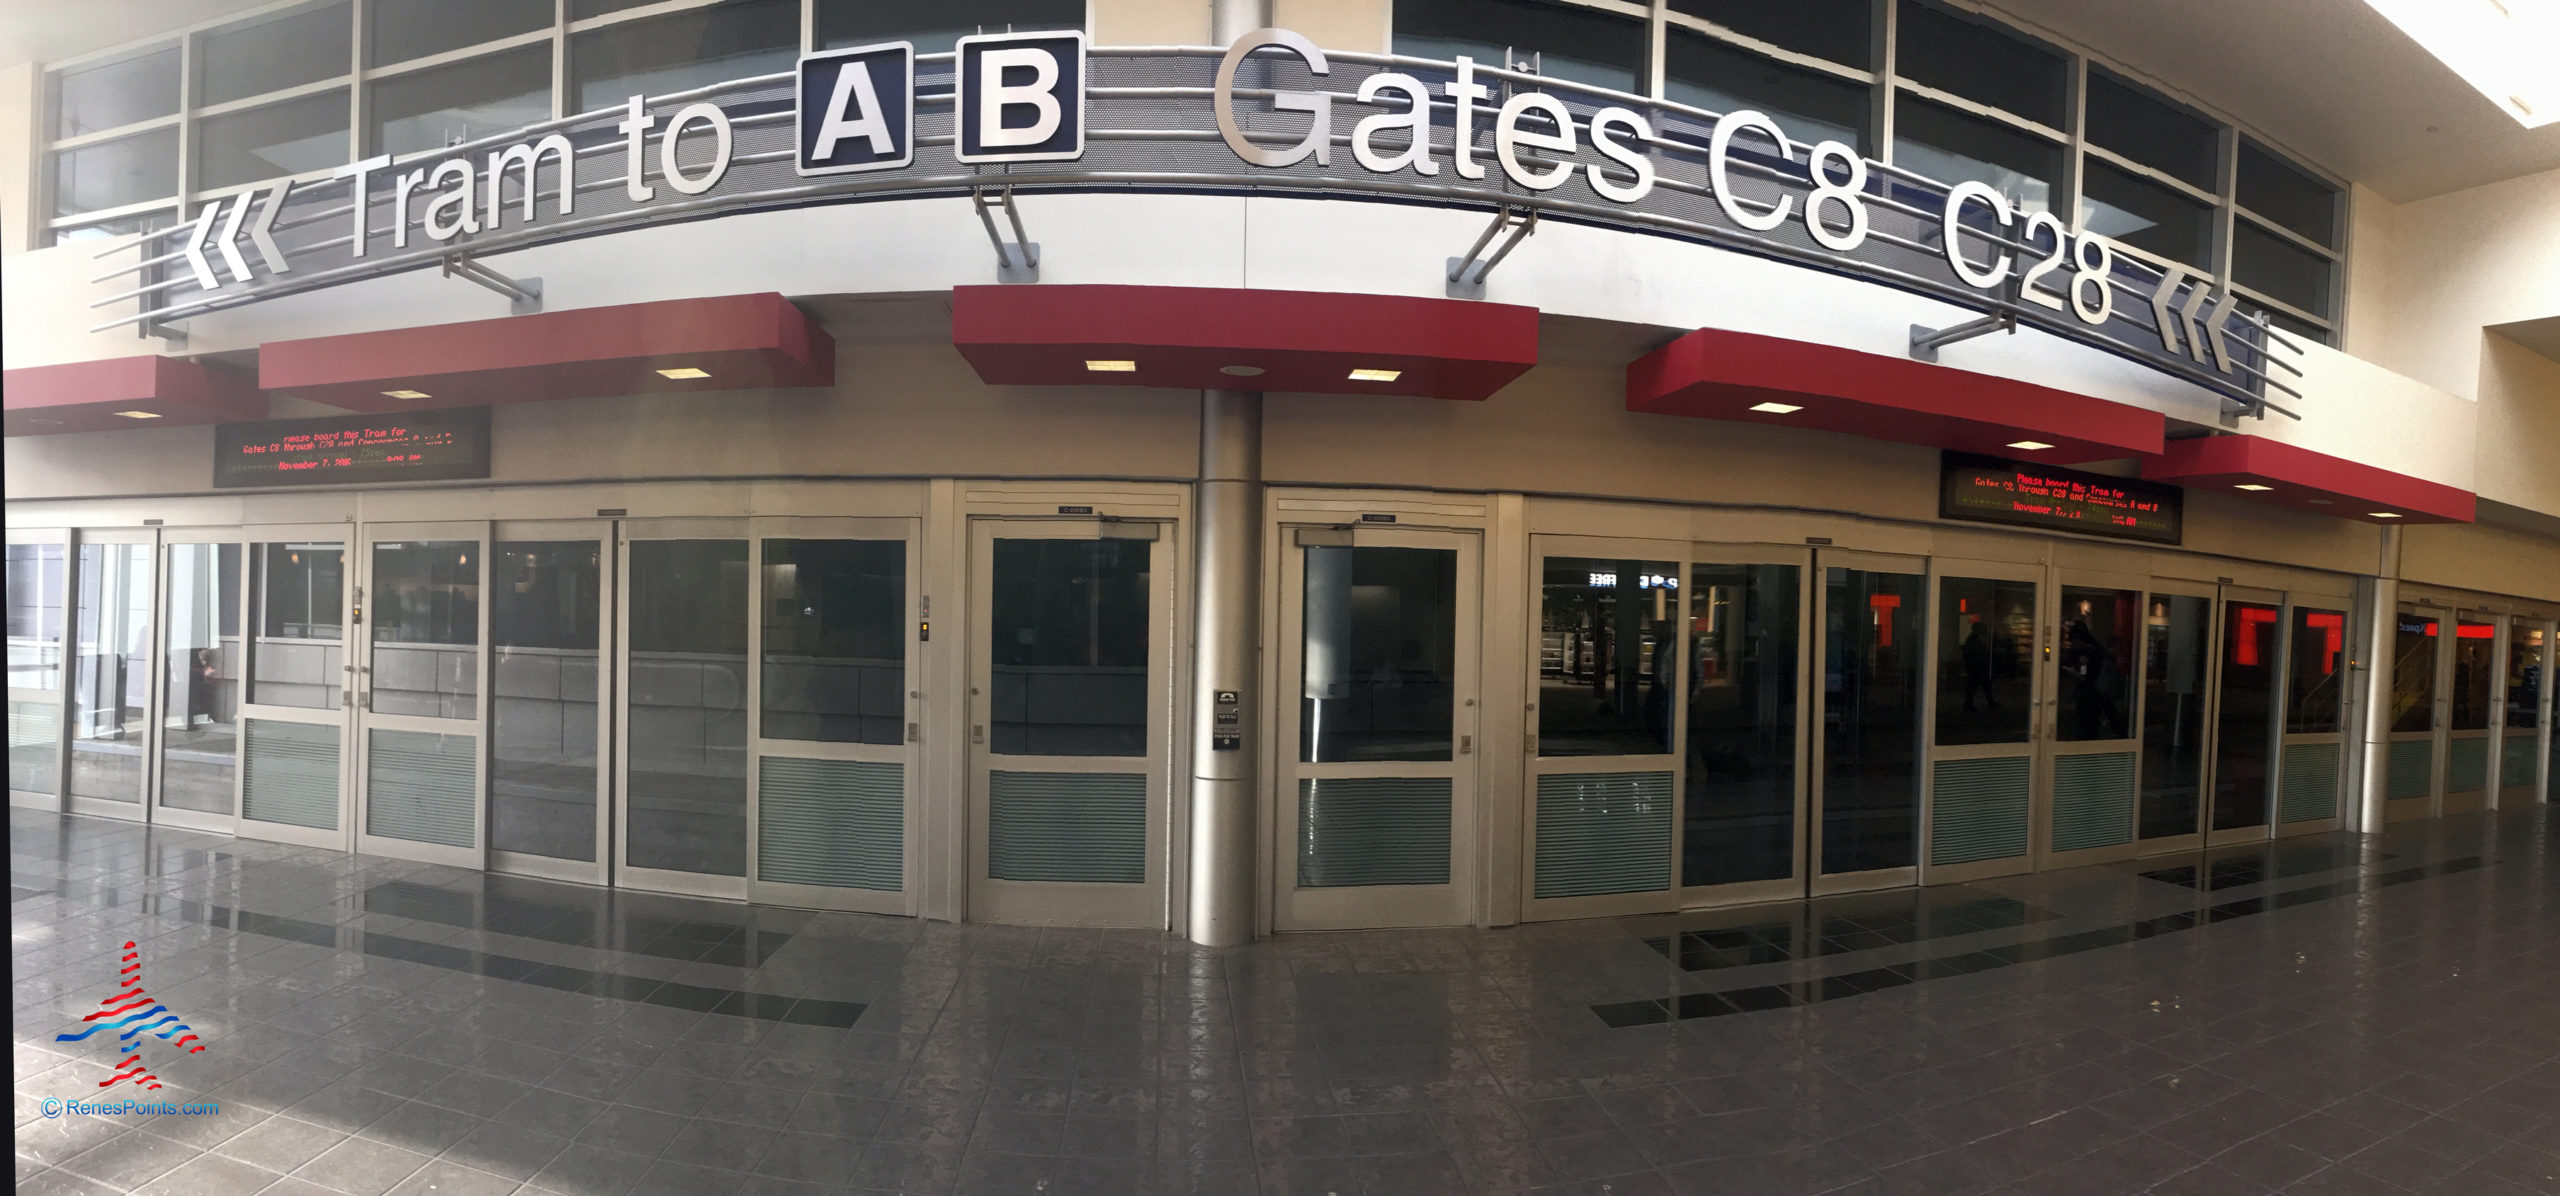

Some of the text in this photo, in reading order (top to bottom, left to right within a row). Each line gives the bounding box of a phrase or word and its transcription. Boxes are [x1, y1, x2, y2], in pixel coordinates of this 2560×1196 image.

[334, 27, 2113, 325] Tram to A B Gates C8 C28
[364, 428, 387, 439] Tram
[243, 444, 266, 454] Gates
[2017, 473, 2043, 487] Please
[2091, 485, 2110, 496] Tram
[2112, 488, 2125, 500] for
